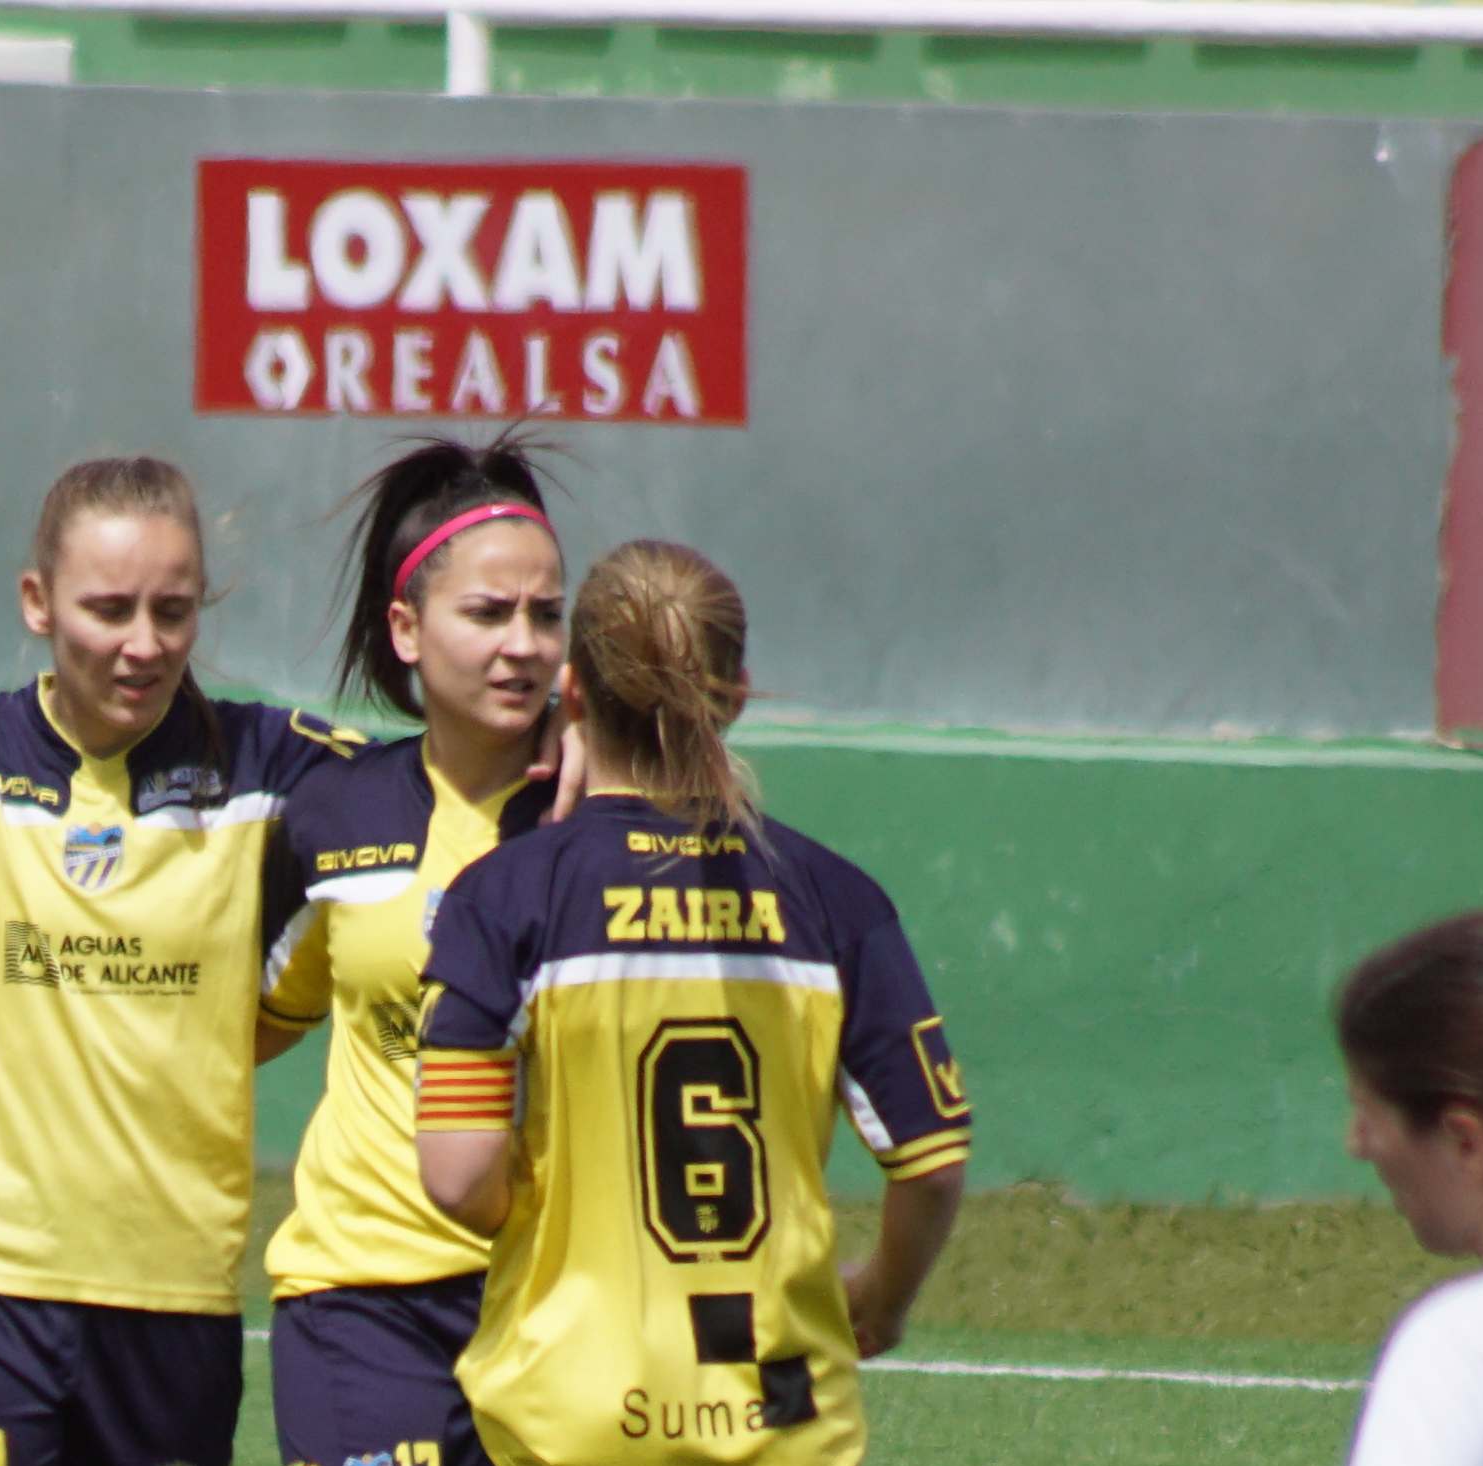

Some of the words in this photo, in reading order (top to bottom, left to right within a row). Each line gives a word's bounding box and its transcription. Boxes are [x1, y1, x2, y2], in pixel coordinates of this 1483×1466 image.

[246, 187, 701, 312] LOXAM
[317, 842, 415, 872] GIVOVA
[603, 886, 786, 943] ZAIRA
[60, 935, 142, 957] AGUAS
[61, 964, 84, 983] DE
[101, 961, 200, 985] ALICANTE
[636, 1017, 771, 1263] 6
[621, 1388, 765, 1439] Suma
